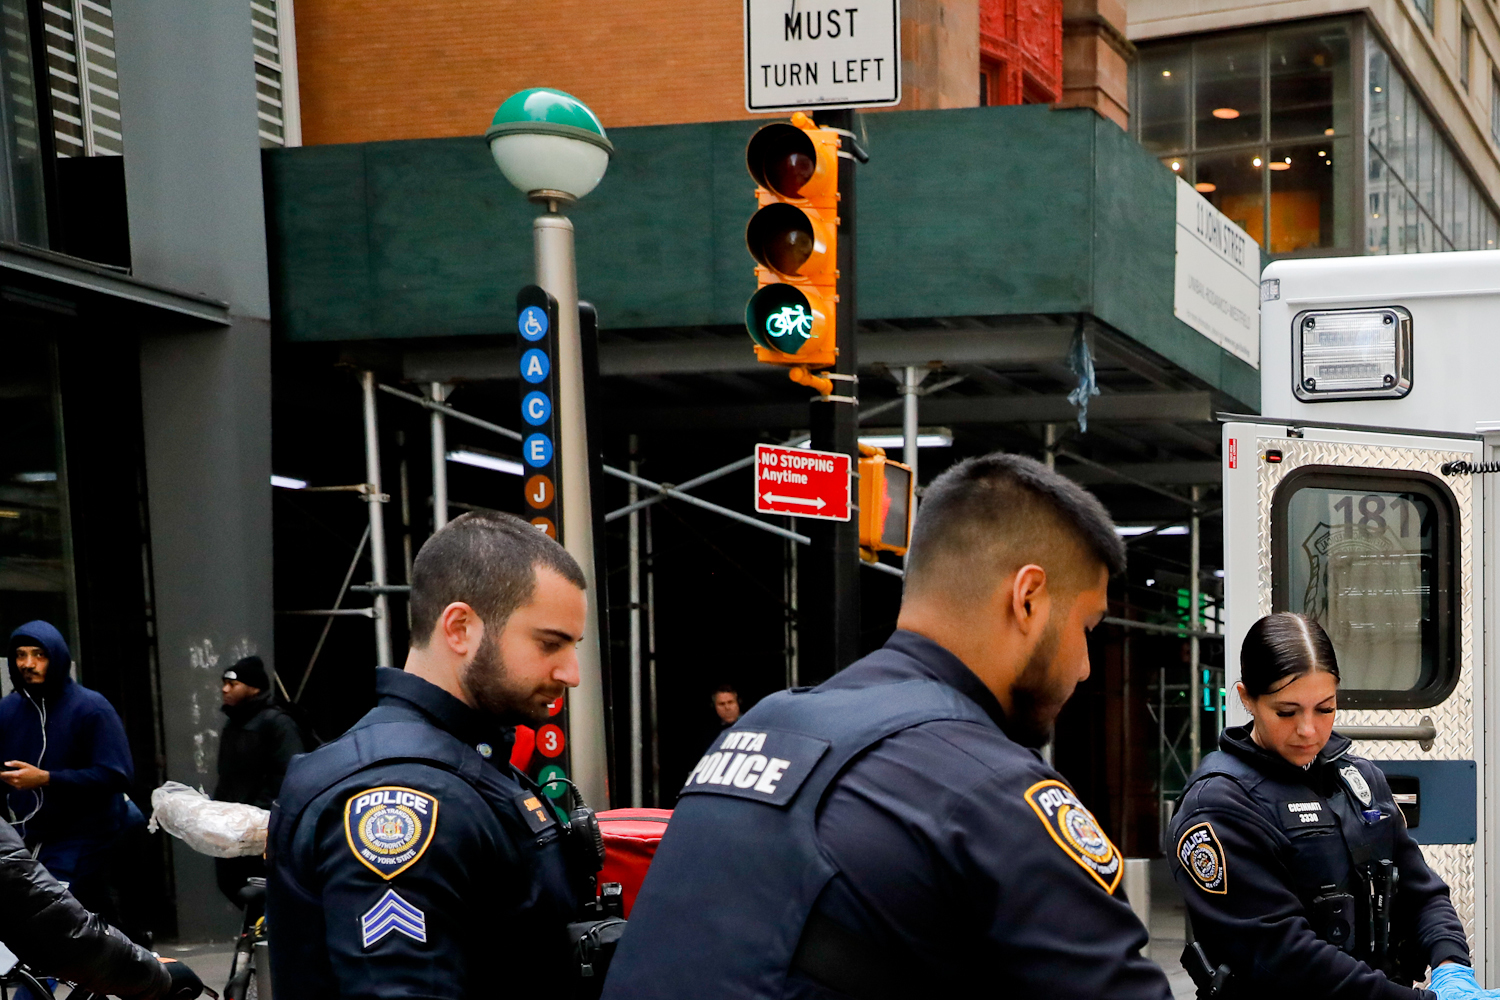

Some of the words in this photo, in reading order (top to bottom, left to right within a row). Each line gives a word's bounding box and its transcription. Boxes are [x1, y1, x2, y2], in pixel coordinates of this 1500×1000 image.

[785, 9, 858, 41] MUST
[761, 62, 818, 88] TURN
[833, 58, 884, 84] LEFT
[527, 355, 543, 376] A
[528, 398, 544, 419] C
[531, 440, 545, 460] E
[761, 452, 778, 466] NO
[780, 454, 834, 473] STOPPING
[762, 467, 808, 485] Anytime
[533, 482, 546, 503] J
[545, 731, 558, 750] 3
[720, 731, 767, 752] MTA
[546, 771, 558, 791] 4
[685, 752, 791, 794] POLICE
[355, 791, 429, 815] POLICE
[361, 848, 378, 862] NEW
[377, 856, 397, 865] YORK
[396, 848, 417, 864] STATE
[1181, 830, 1211, 866] POLICE
